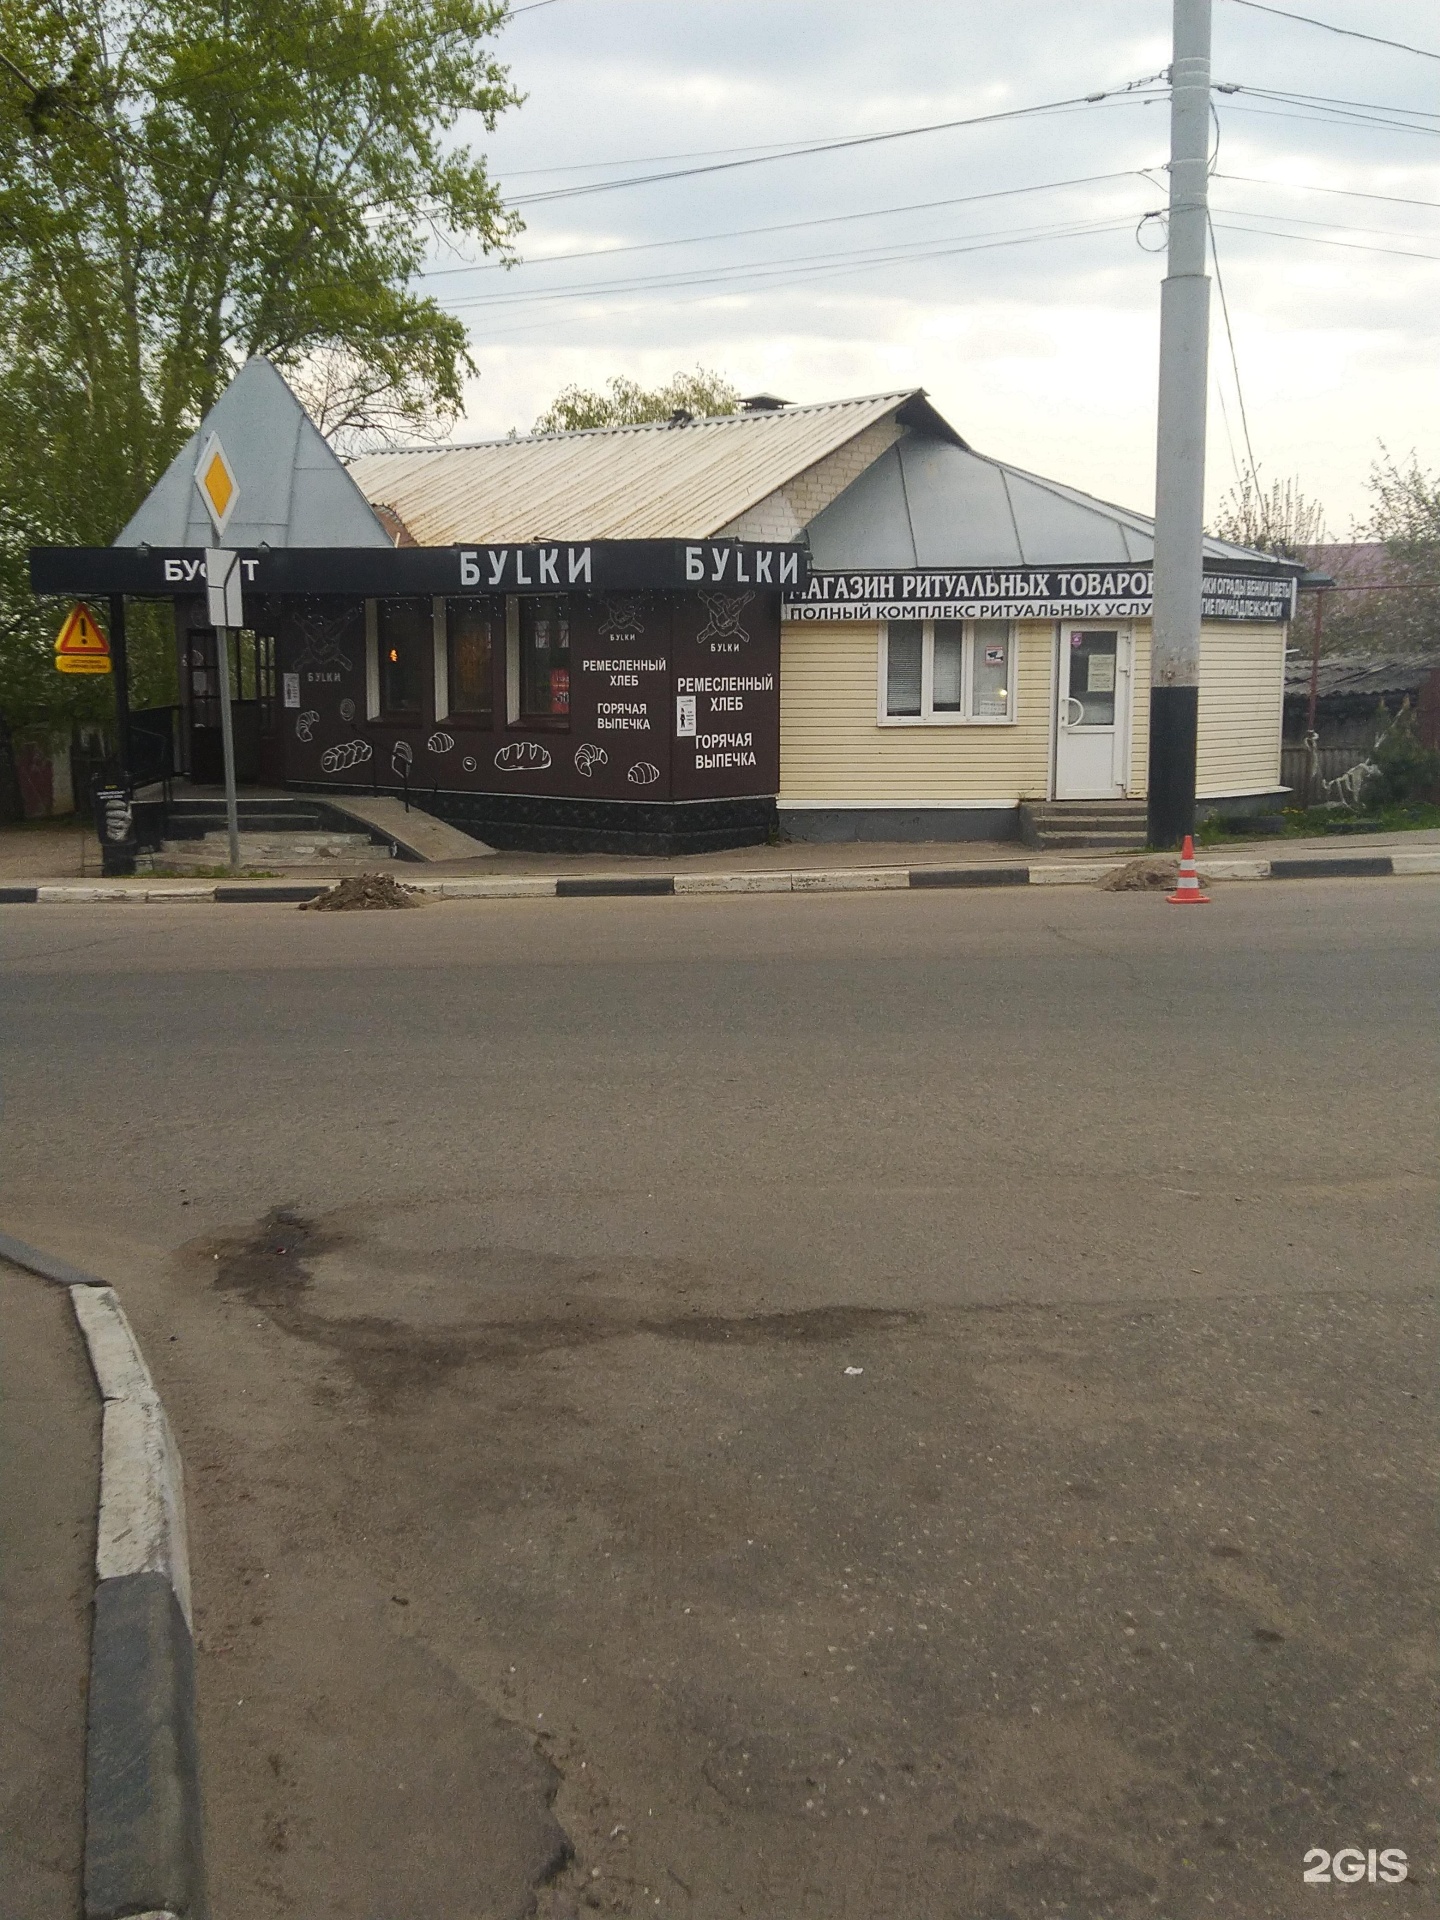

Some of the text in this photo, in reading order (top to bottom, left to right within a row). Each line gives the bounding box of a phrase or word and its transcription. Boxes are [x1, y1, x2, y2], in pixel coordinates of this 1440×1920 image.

[164, 559, 259, 581] БУТ
[789, 575, 894, 600] АГАЗИН
[902, 573, 1049, 598] РИТУАЛЬНЫХ
[790, 602, 1153, 620] ПОЛНЫЙ КОМПЛЕКС РИТУАЛЬНЫХ УСЛУ
[582, 657, 666, 672] РЕМЕСЛЕННЫЙ
[610, 673, 639, 687] ХЛЕБ
[677, 673, 774, 693] РЕМЕСЛЕННЫЙ
[597, 702, 647, 716] ГОРЯЧАЯ
[710, 696, 744, 712] ХЛЕБ
[597, 716, 651, 731] ВЫПЕЧКА
[695, 732, 753, 750] ГОРЯЧАЯ
[695, 751, 757, 769] ВЫПЕЧКА
